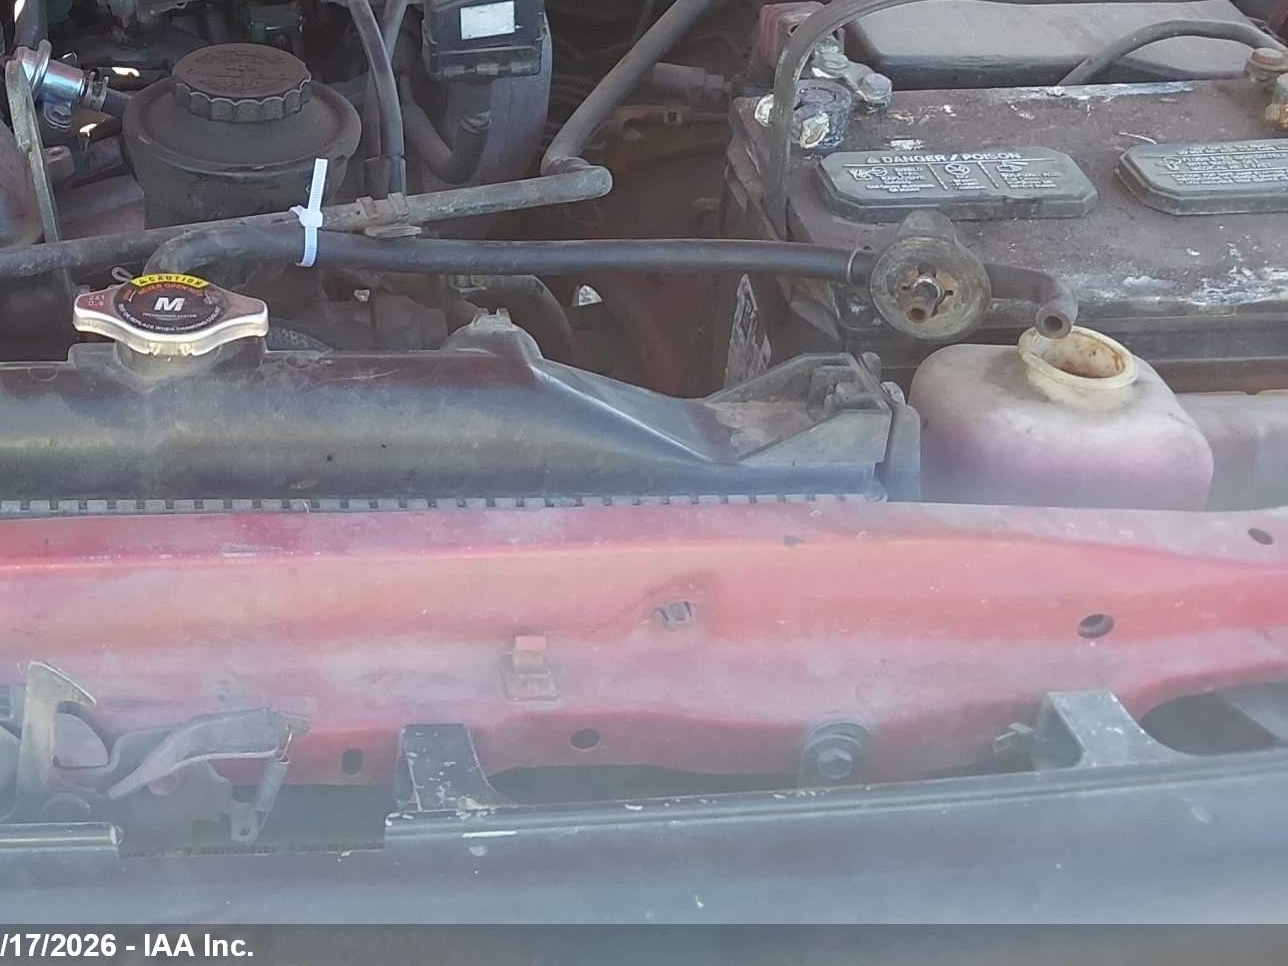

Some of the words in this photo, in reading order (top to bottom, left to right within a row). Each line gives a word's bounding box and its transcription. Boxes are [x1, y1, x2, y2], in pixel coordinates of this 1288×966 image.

[880, 153, 946, 164] DANGER
[962, 152, 1021, 161] POISON
[148, 275, 203, 286] CAUTION
[153, 297, 186, 312] M
